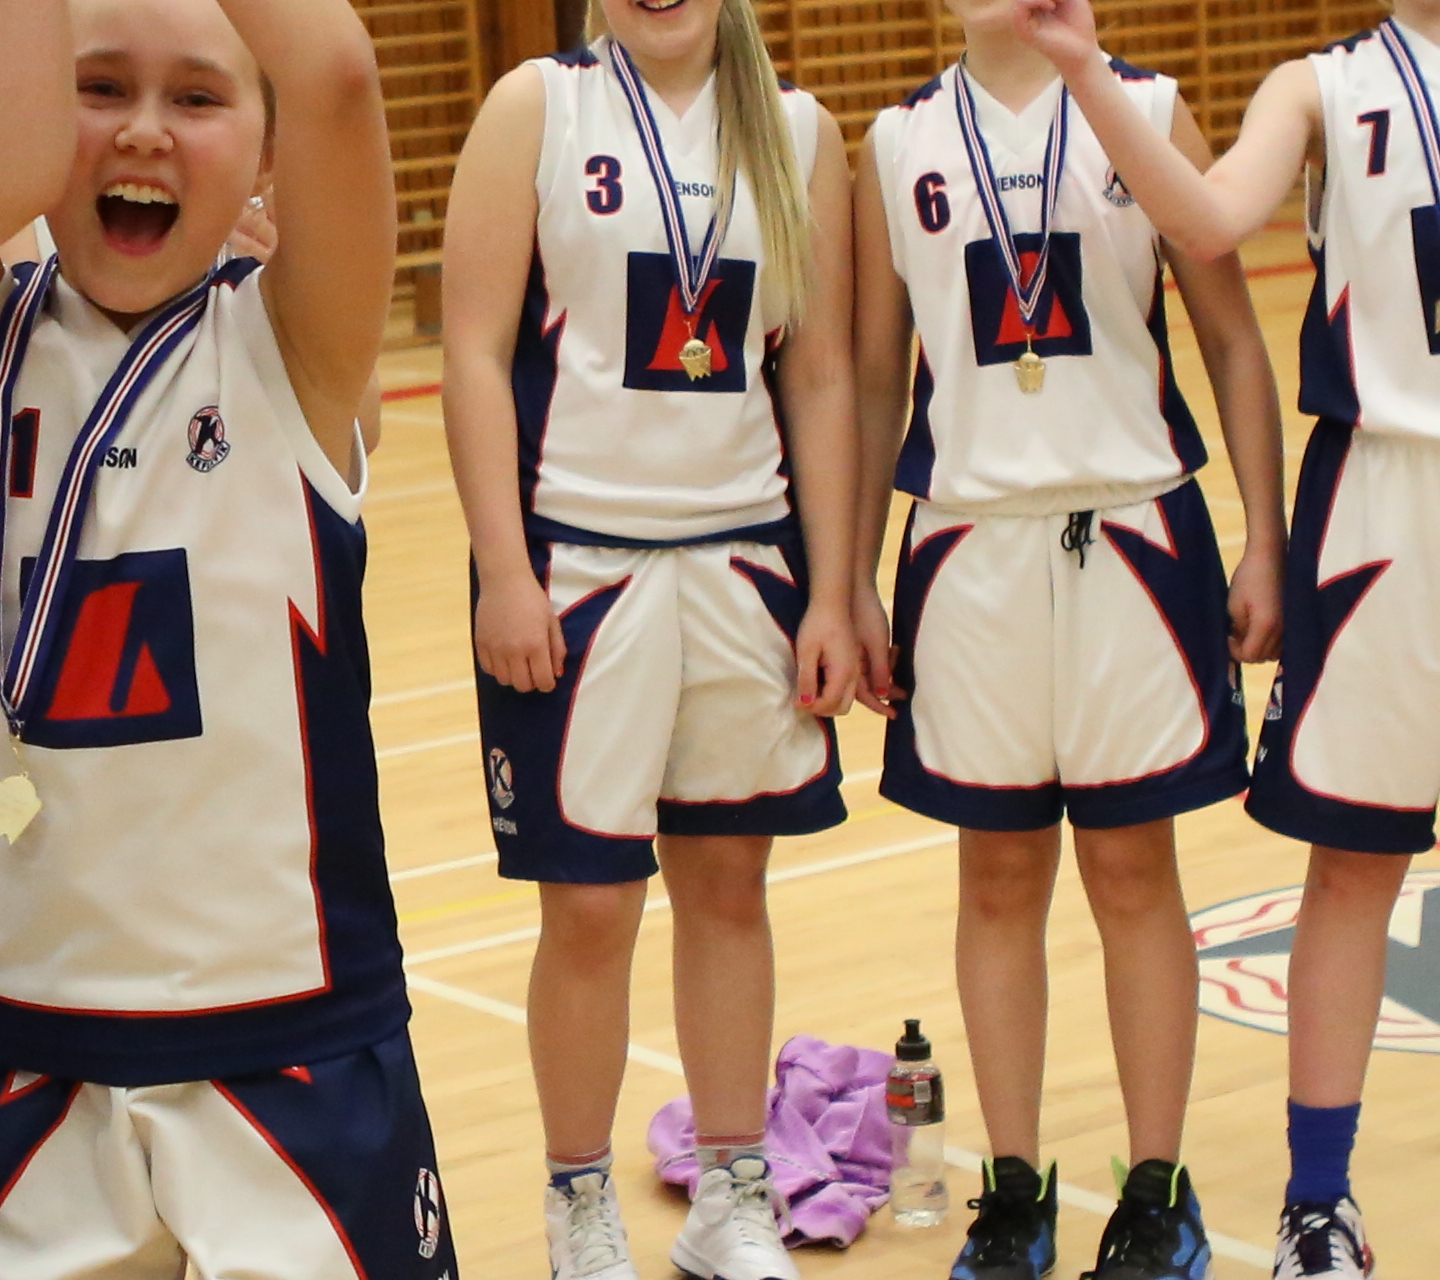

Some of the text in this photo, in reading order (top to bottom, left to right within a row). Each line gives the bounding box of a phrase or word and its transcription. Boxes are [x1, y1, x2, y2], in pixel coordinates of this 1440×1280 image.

[584, 154, 625, 216] 3
[674, 181, 716, 198] ENSO
[913, 171, 952, 235] 6
